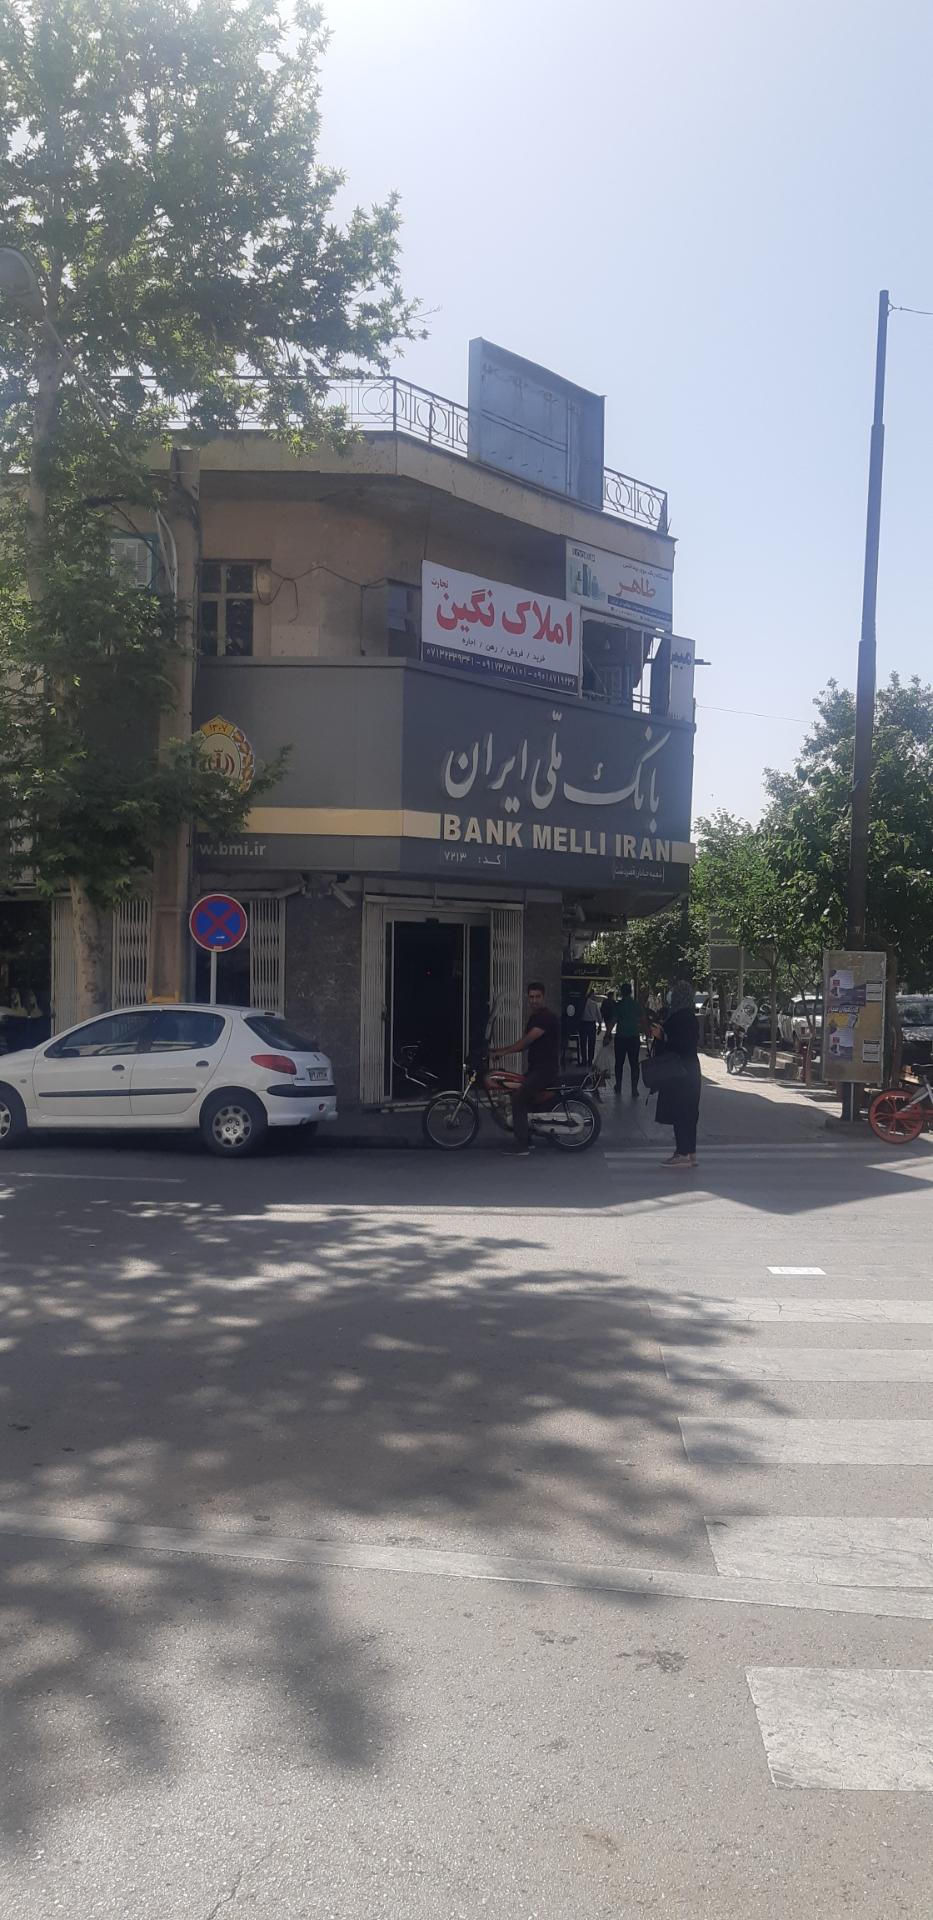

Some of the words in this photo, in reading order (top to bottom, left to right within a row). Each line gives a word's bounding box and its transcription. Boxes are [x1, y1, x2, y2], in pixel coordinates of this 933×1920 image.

[437, 589, 495, 632] نگین
[502, 600, 573, 647] املاک
[209, 724, 228, 732] ۱۳۰۷
[444, 732, 528, 814] ایران
[443, 813, 523, 848] BANK
[532, 825, 606, 856] MELLI
[615, 834, 670, 863] IRAN
[444, 850, 467, 863] ۷۲۱۳
